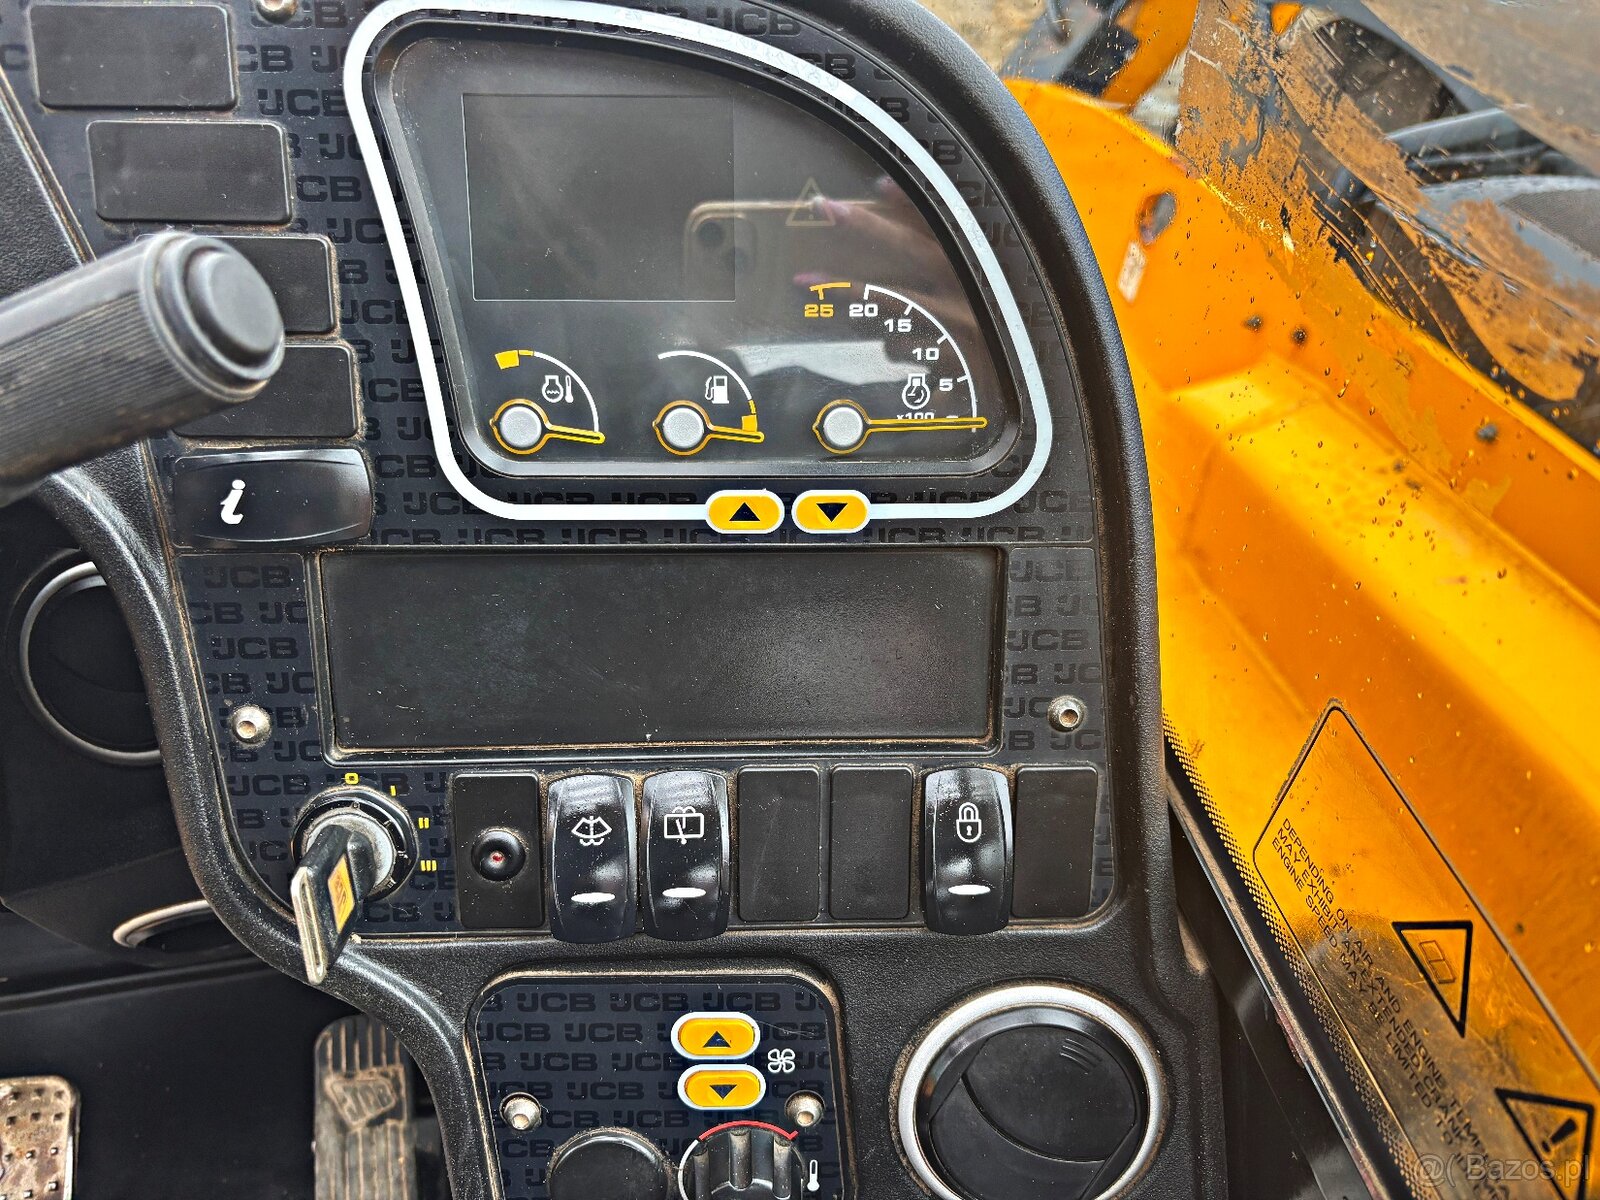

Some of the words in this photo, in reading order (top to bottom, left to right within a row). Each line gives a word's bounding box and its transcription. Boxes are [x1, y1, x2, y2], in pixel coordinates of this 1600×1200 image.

[237, 45, 293, 73] CB
[297, 176, 361, 202] CB
[804, 303, 834, 318] 25
[849, 303, 878, 317] 20
[884, 318, 912, 333] 15
[912, 347, 940, 361] 10
[362, 378, 425, 402] CB
[939, 378, 953, 392] 5
[375, 455, 437, 478] CB
[371, 528, 441, 544] CB
[204, 566, 290, 588] JCB
[189, 602, 244, 624] CB
[259, 602, 308, 624] JC
[211, 637, 299, 660] JCB
[1007, 629, 1088, 651] JCB
[204, 673, 251, 694] CB
[266, 672, 315, 694] JC
[1054, 663, 1100, 684] JC
[1004, 697, 1053, 718] JC
[1051, 729, 1101, 750] JC
[273, 740, 323, 762] JC
[1277, 828, 1301, 863] MAY
[1302, 868, 1341, 930] EXHIBIT
[1341, 940, 1361, 966] AN
[1360, 968, 1421, 1069] EXTENDED
[1282, 818, 1334, 905] DEPENDING
[1336, 908, 1353, 934] ON
[1353, 940, 1374, 969] AIR
[1374, 975, 1401, 1014] AND
[1402, 1018, 1446, 1088] ENGINE
[1271, 837, 1305, 892] ENGINE
[1305, 895, 1338, 948] SPEED
[1385, 1031, 1433, 1108] LIMITED
[517, 993, 596, 1012] JCB
[610, 992, 689, 1012] JCB
[703, 992, 781, 1011] JCB
[564, 1023, 643, 1042] JCB
[762, 1022, 826, 1041] CB
[520, 1052, 598, 1071] JCB
[567, 1082, 645, 1100] JCB
[541, 1110, 600, 1128] CB
[613, 1110, 689, 1128] JCB
[501, 1139, 555, 1158] CB
